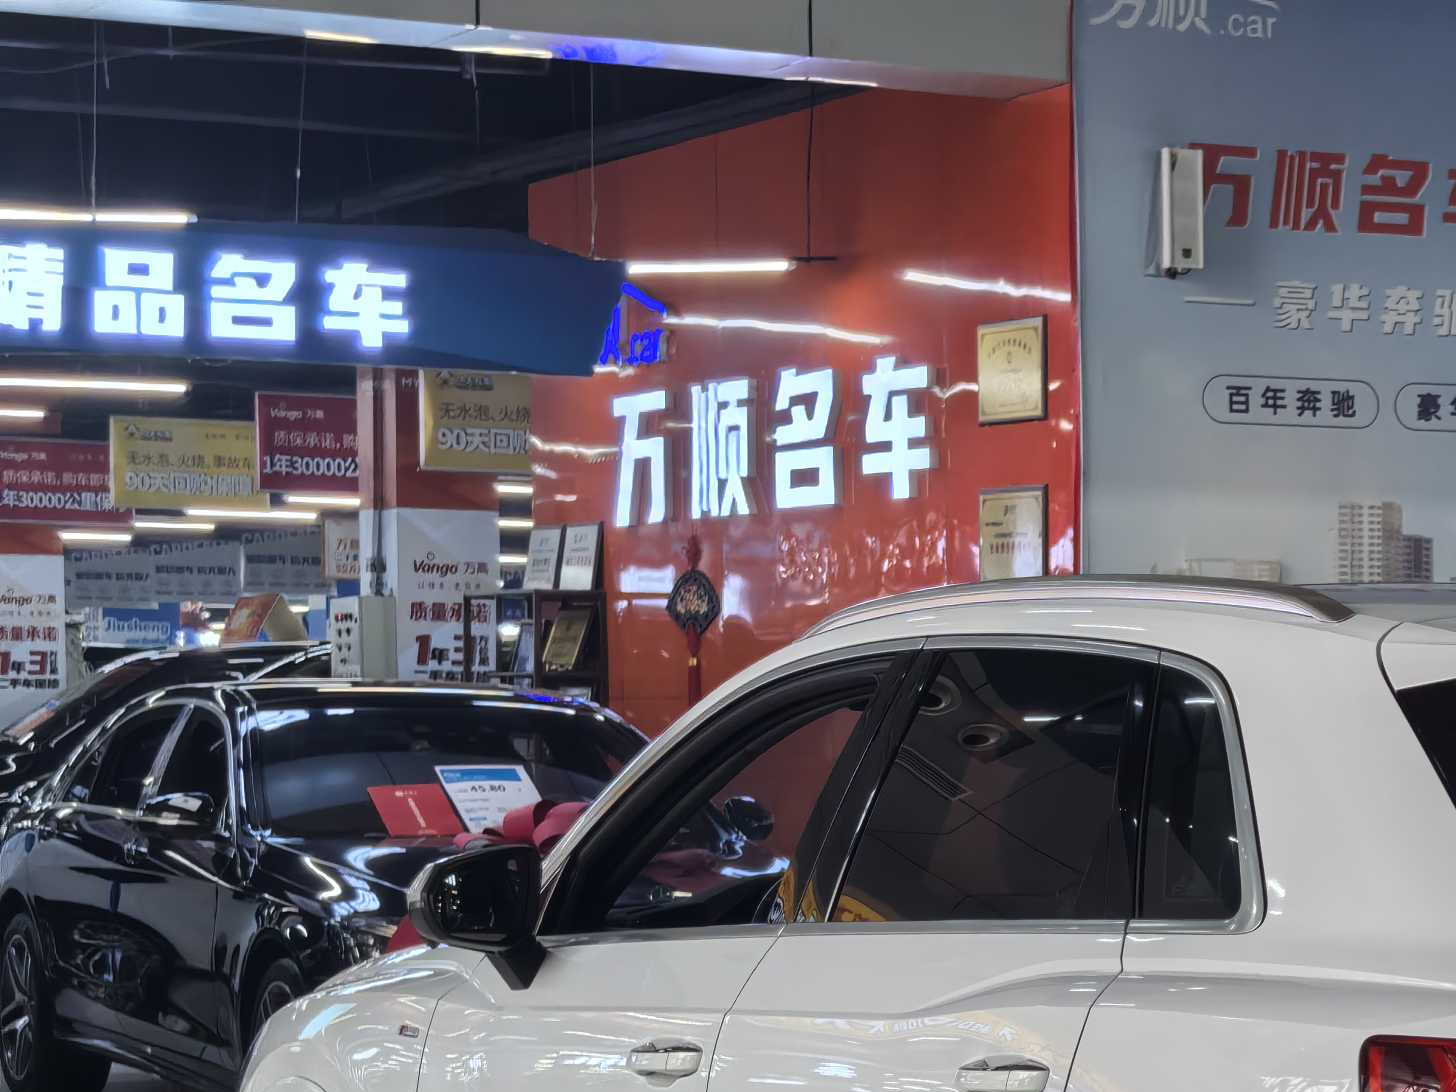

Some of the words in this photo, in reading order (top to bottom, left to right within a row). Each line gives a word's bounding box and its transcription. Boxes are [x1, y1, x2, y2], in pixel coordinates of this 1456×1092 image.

[1226, 383, 1357, 420] 百年奔驰
[613, 356, 930, 527] 万顺名车
[413, 559, 458, 577] Vango
